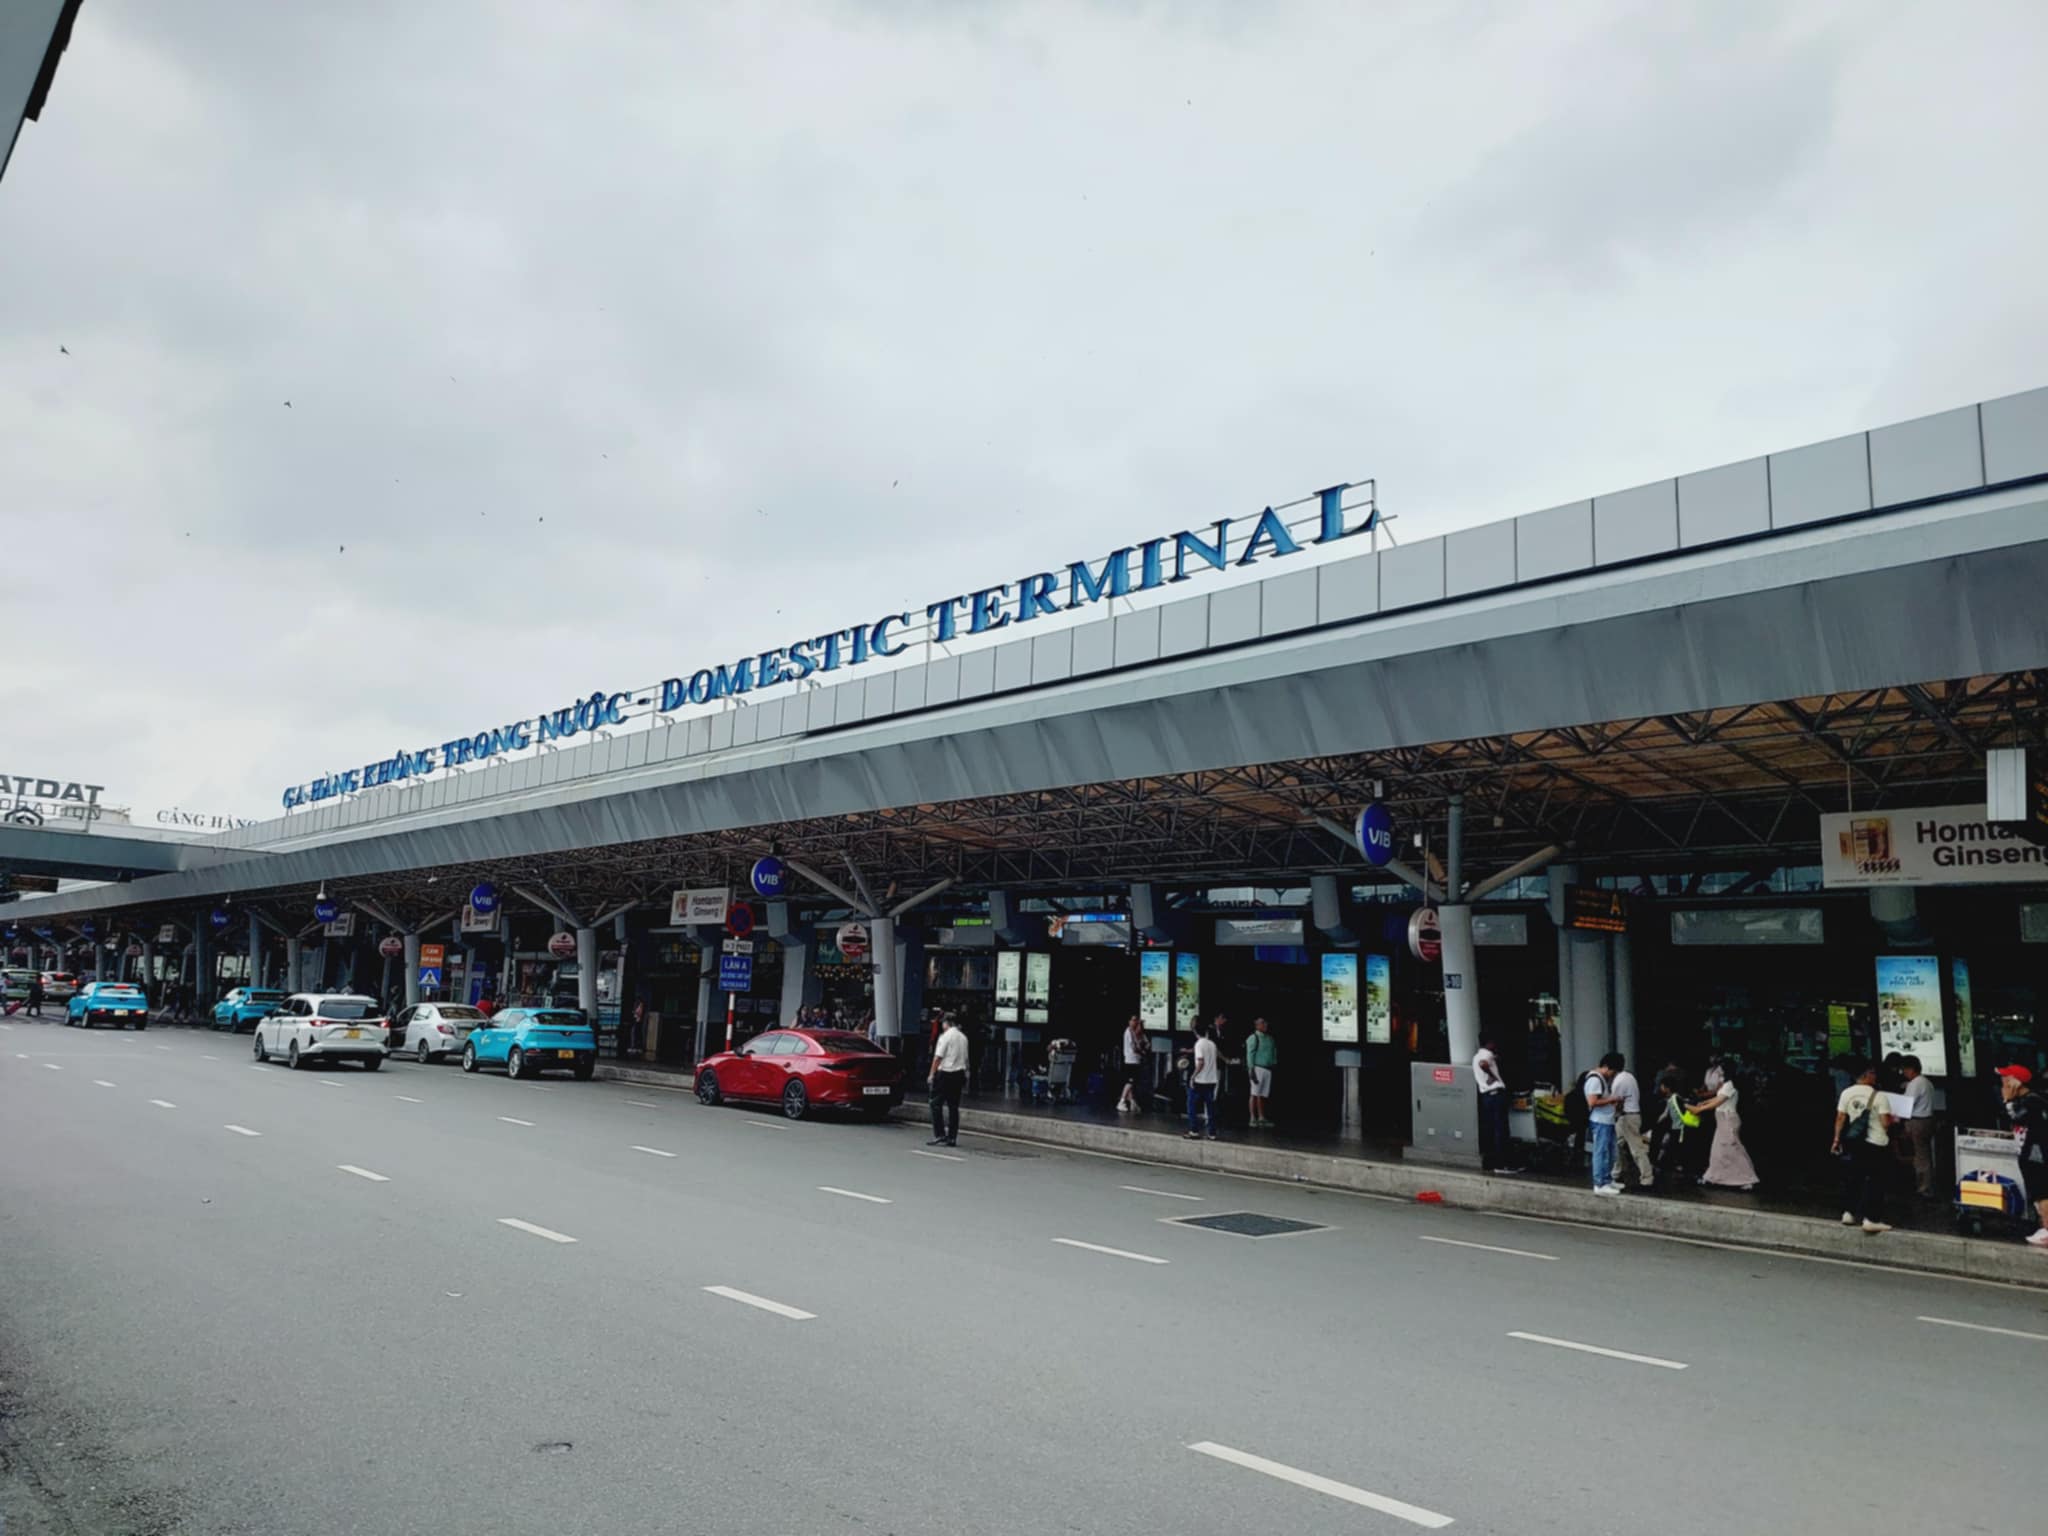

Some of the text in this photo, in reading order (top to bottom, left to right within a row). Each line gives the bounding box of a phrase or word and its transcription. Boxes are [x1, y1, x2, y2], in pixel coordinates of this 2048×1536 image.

[362, 749, 437, 788] KHÔNG
[440, 720, 531, 768] TRONG
[537, 691, 632, 744] NƯỚC
[660, 613, 911, 713] DOMESTIC
[926, 483, 1379, 643] TERMINAL
[1368, 826, 1391, 848] VIB
[758, 872, 779, 886] VIB
